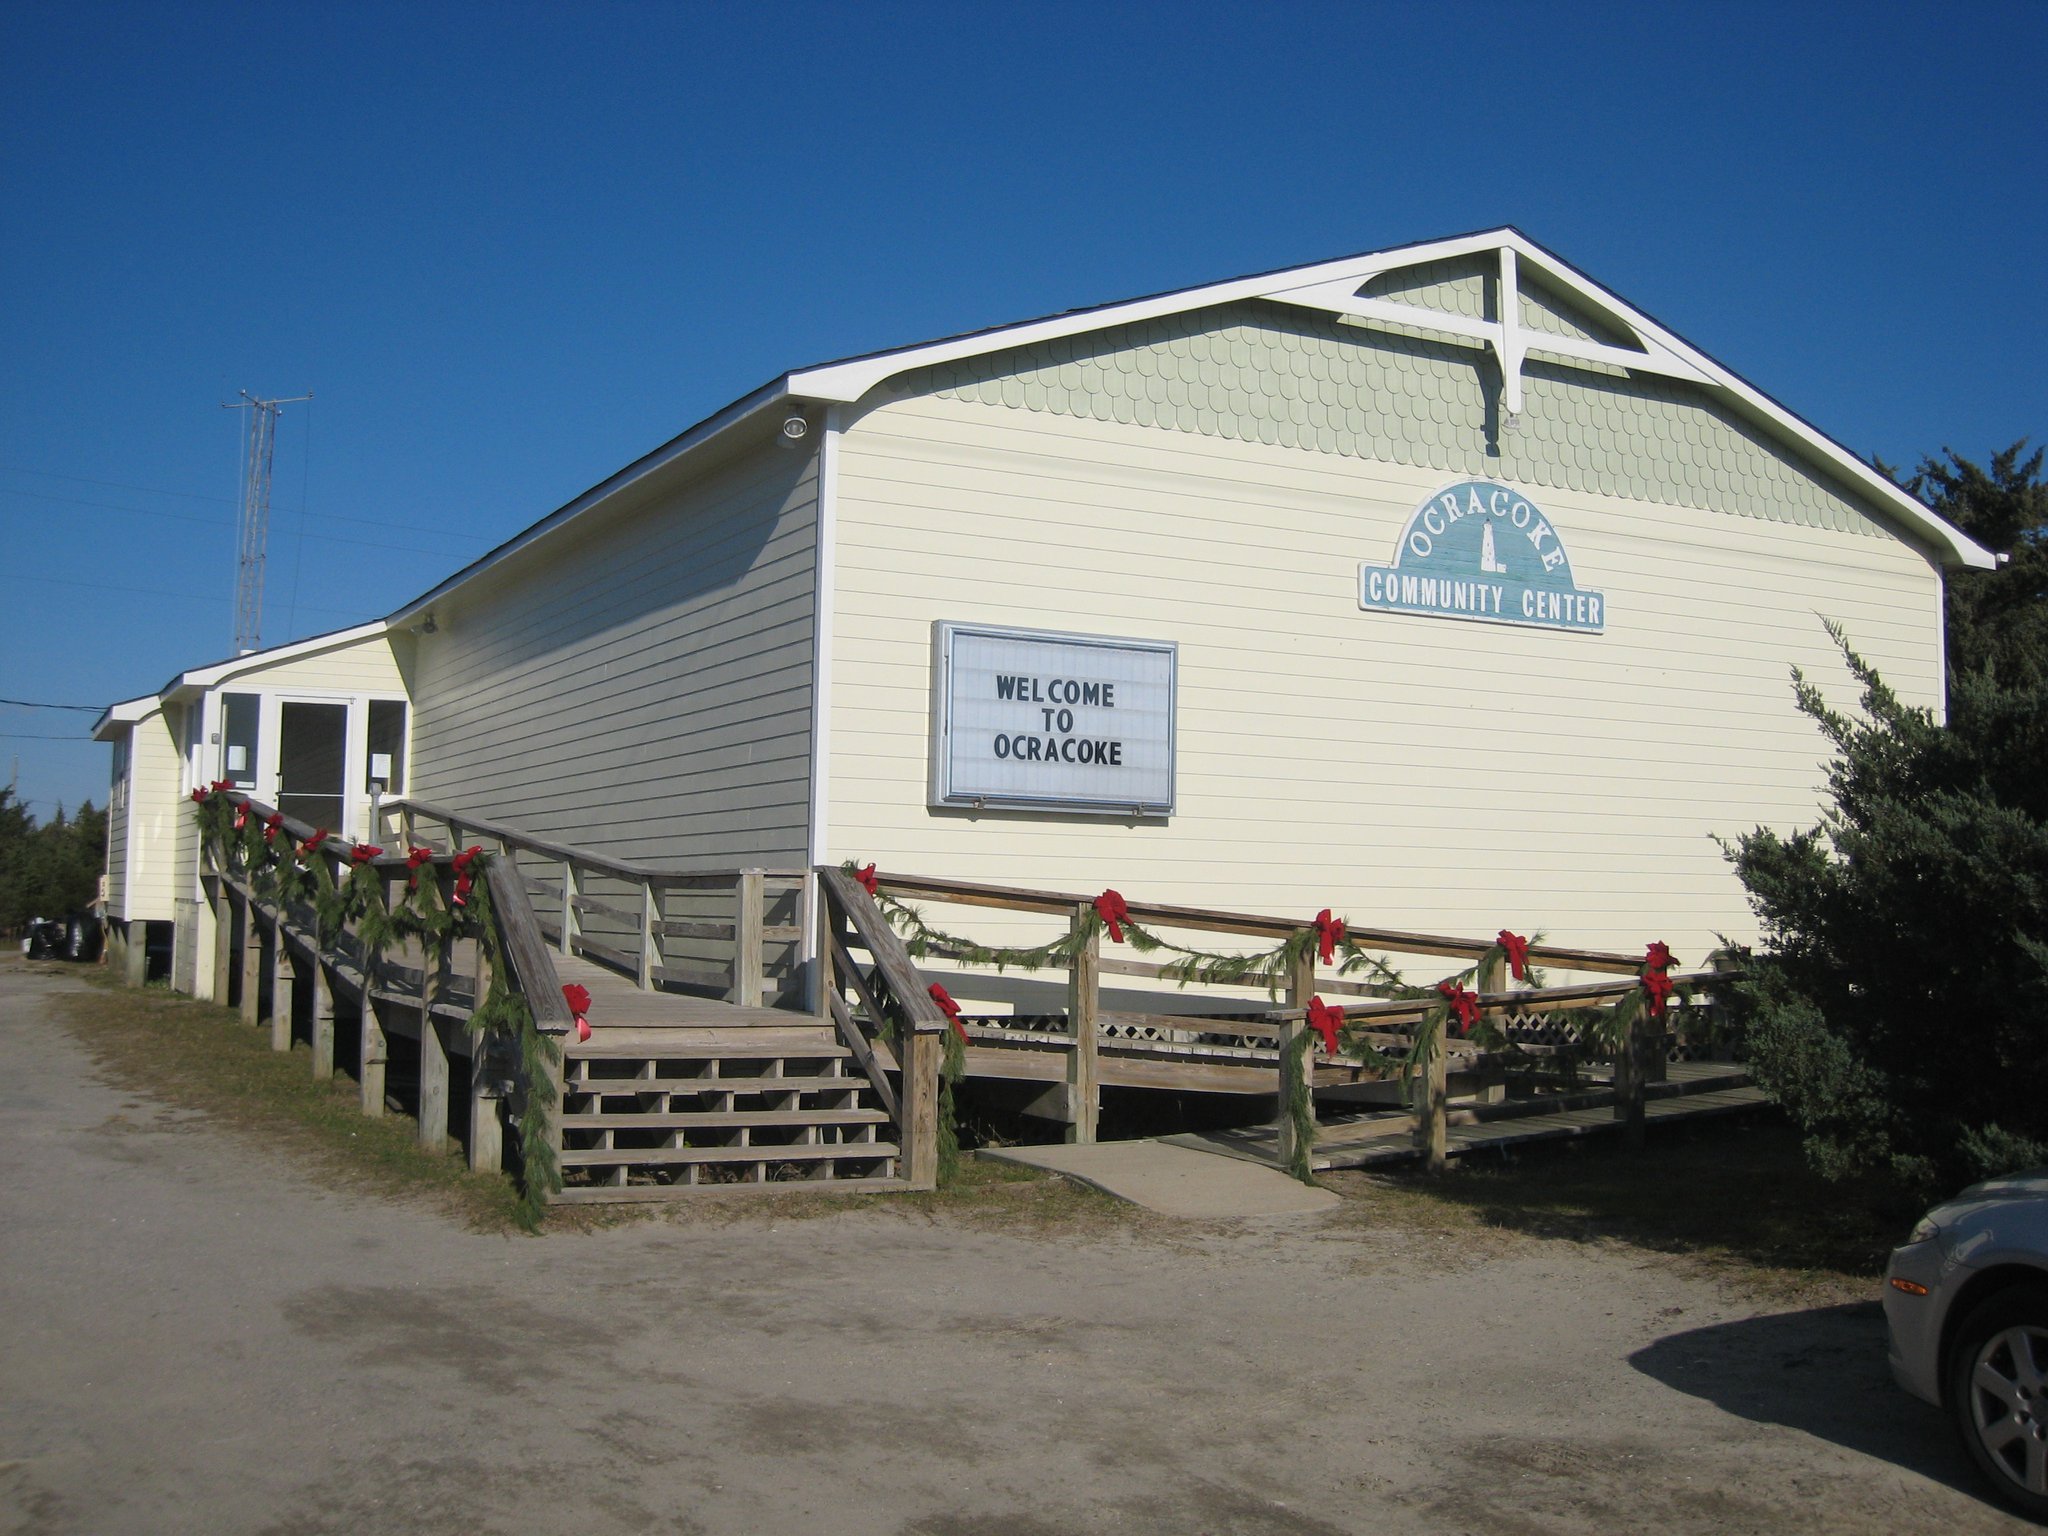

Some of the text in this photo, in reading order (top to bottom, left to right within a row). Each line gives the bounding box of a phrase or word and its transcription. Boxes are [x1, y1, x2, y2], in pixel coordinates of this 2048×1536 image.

[1409, 486, 1565, 573] OCRACOKE
[1369, 571, 1600, 624] COMMUNITY CENTER
[996, 674, 1115, 708] WELCOME
[1041, 708, 1074, 733] TO
[993, 733, 1122, 766] OCRACOKE
